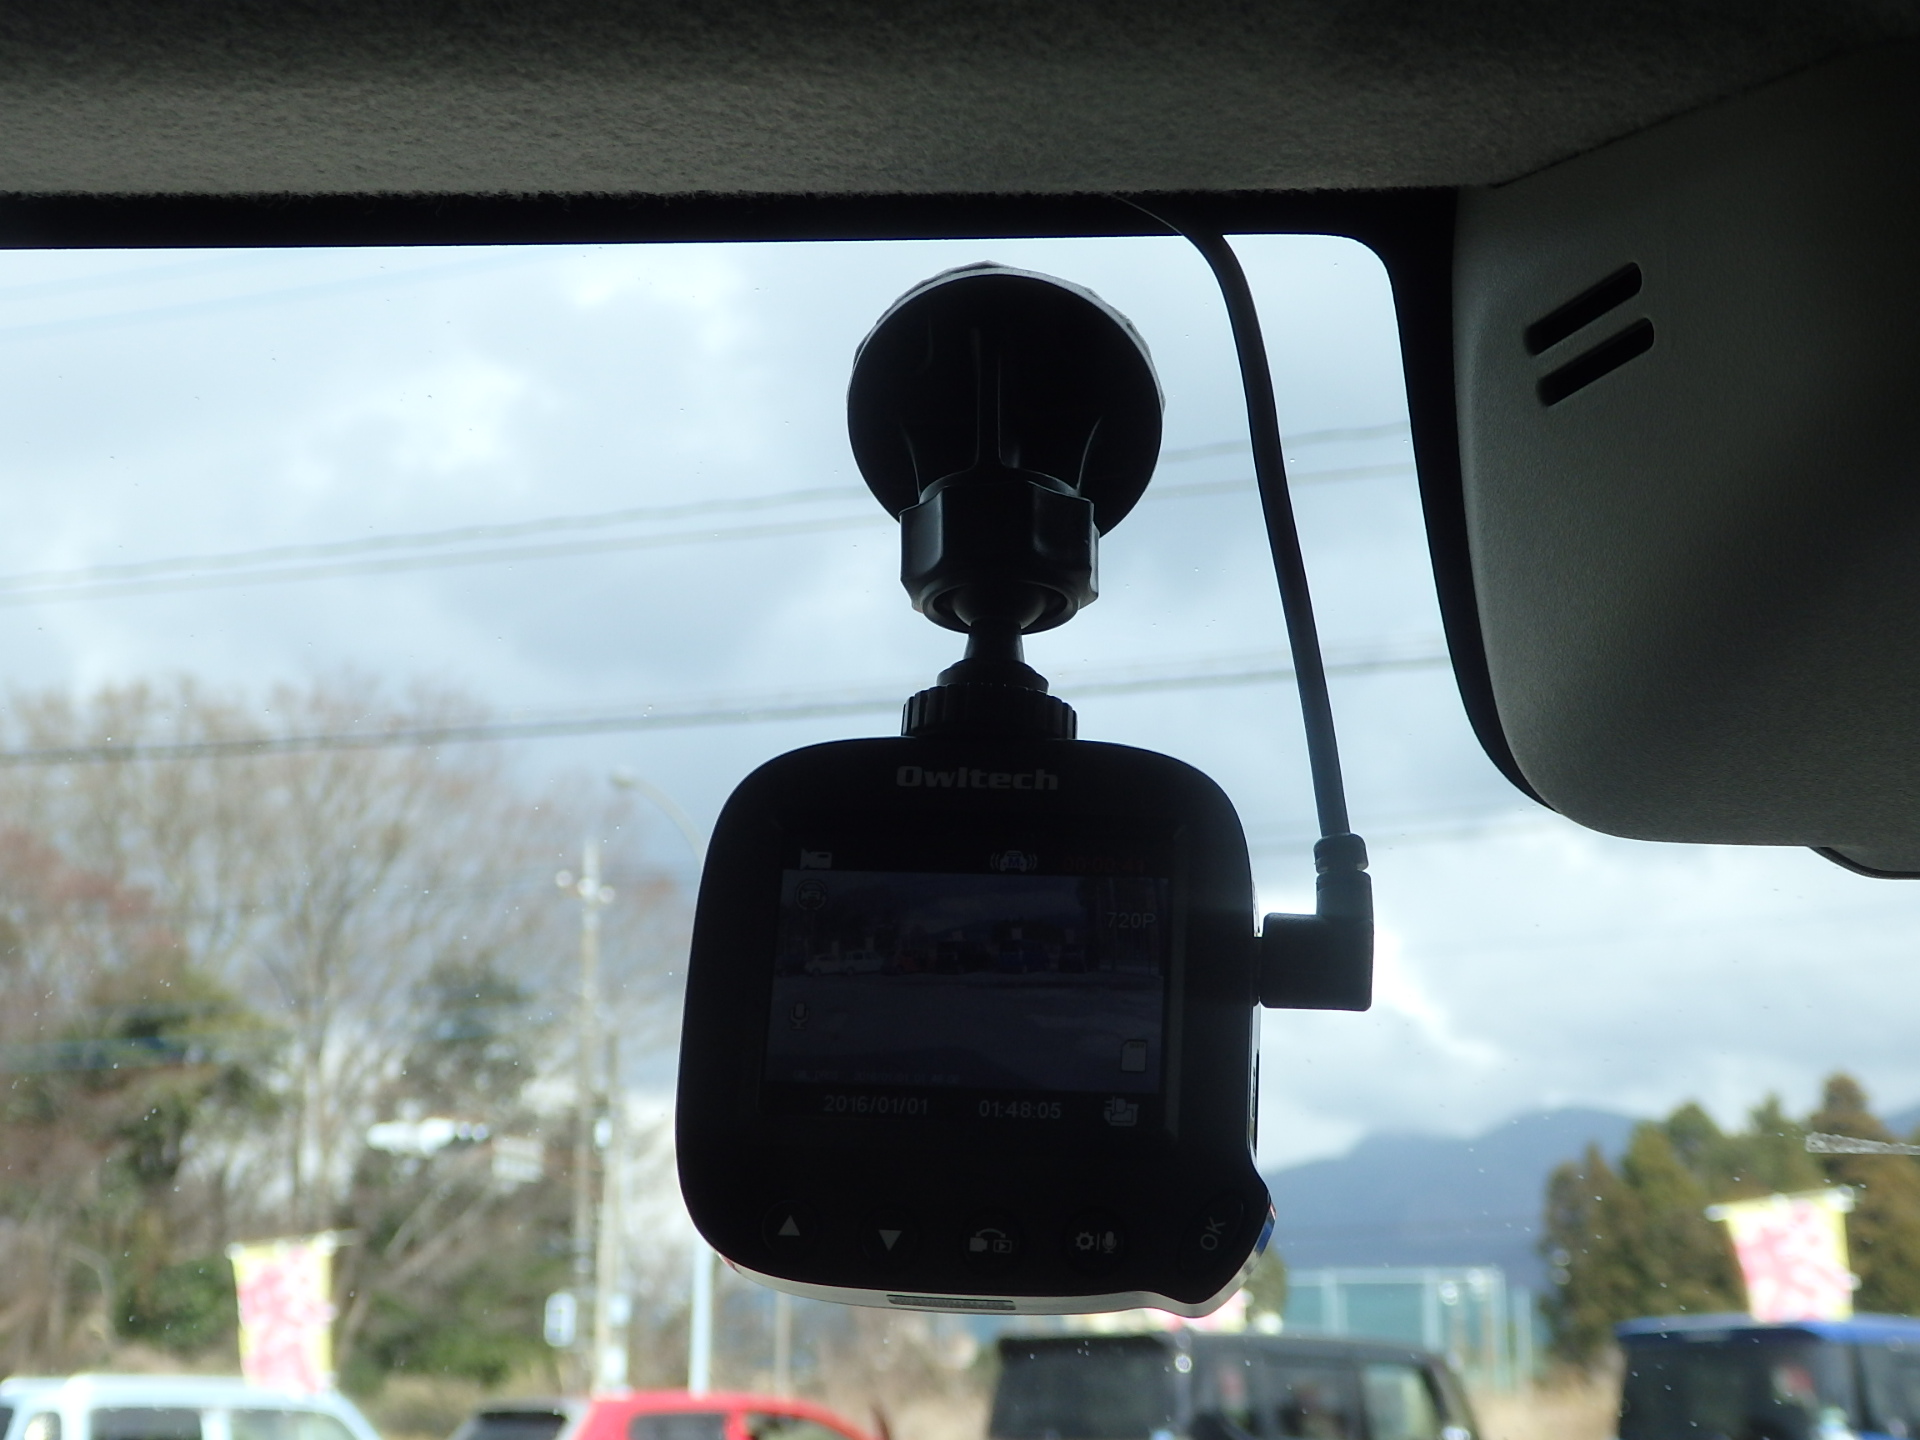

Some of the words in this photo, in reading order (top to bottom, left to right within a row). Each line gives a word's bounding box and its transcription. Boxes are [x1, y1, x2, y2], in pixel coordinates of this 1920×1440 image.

[896, 765, 1059, 791] Owltech
[1106, 911, 1157, 929] 720P
[823, 1094, 930, 1115] 2016/01/01
[977, 1099, 1063, 1120] 01:48:05
[1200, 1216, 1227, 1251] OK
